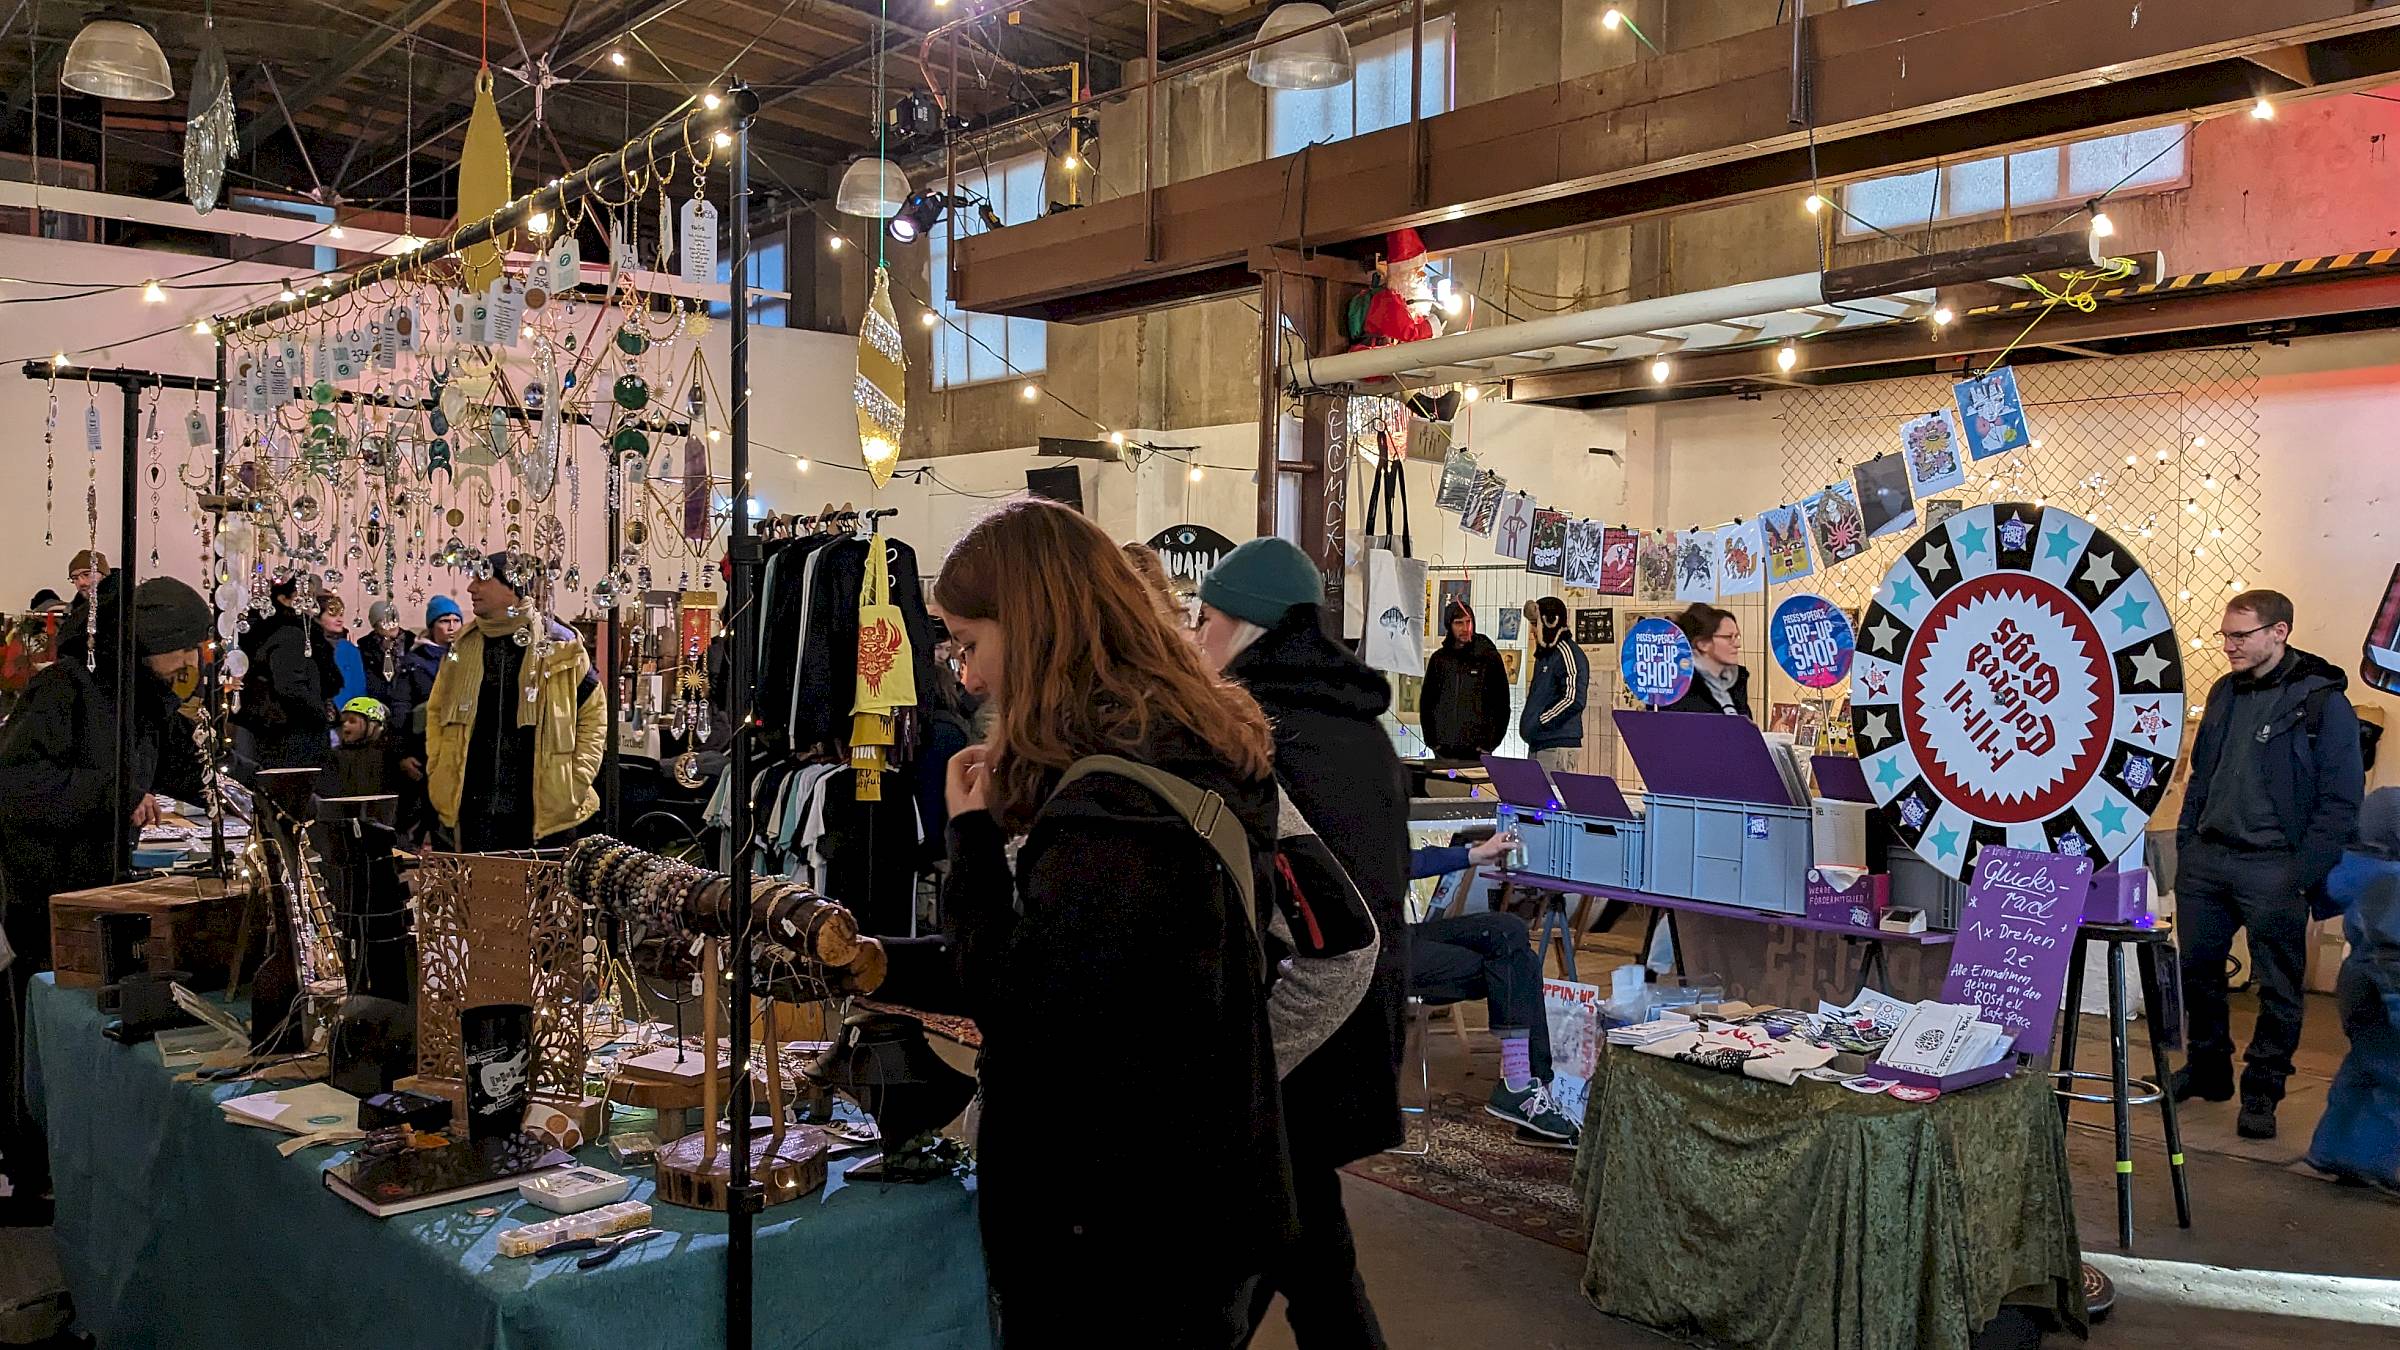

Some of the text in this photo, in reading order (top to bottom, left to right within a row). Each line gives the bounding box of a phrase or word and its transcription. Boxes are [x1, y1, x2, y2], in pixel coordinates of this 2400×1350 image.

[1785, 620, 1833, 645] POP-UP
[1636, 644, 1678, 663] POP-UP
[1790, 638, 1838, 670] SHOP
[1990, 617, 2060, 705] Gigs
[1636, 661, 1678, 688] SHOP
[1966, 642, 2056, 757] Colored
[1943, 679, 2015, 773] MINI
[1983, 859, 2070, 892] Glücks-
[1808, 886, 1831, 895] WERDE
[1969, 920, 2055, 949] 1x Drehen
[2003, 947, 2034, 968] 2€
[1950, 963, 2032, 985] Alle Einnahmen
[1963, 978, 2042, 1001] gehen an den
[1974, 990, 2005, 1007] ROSA
